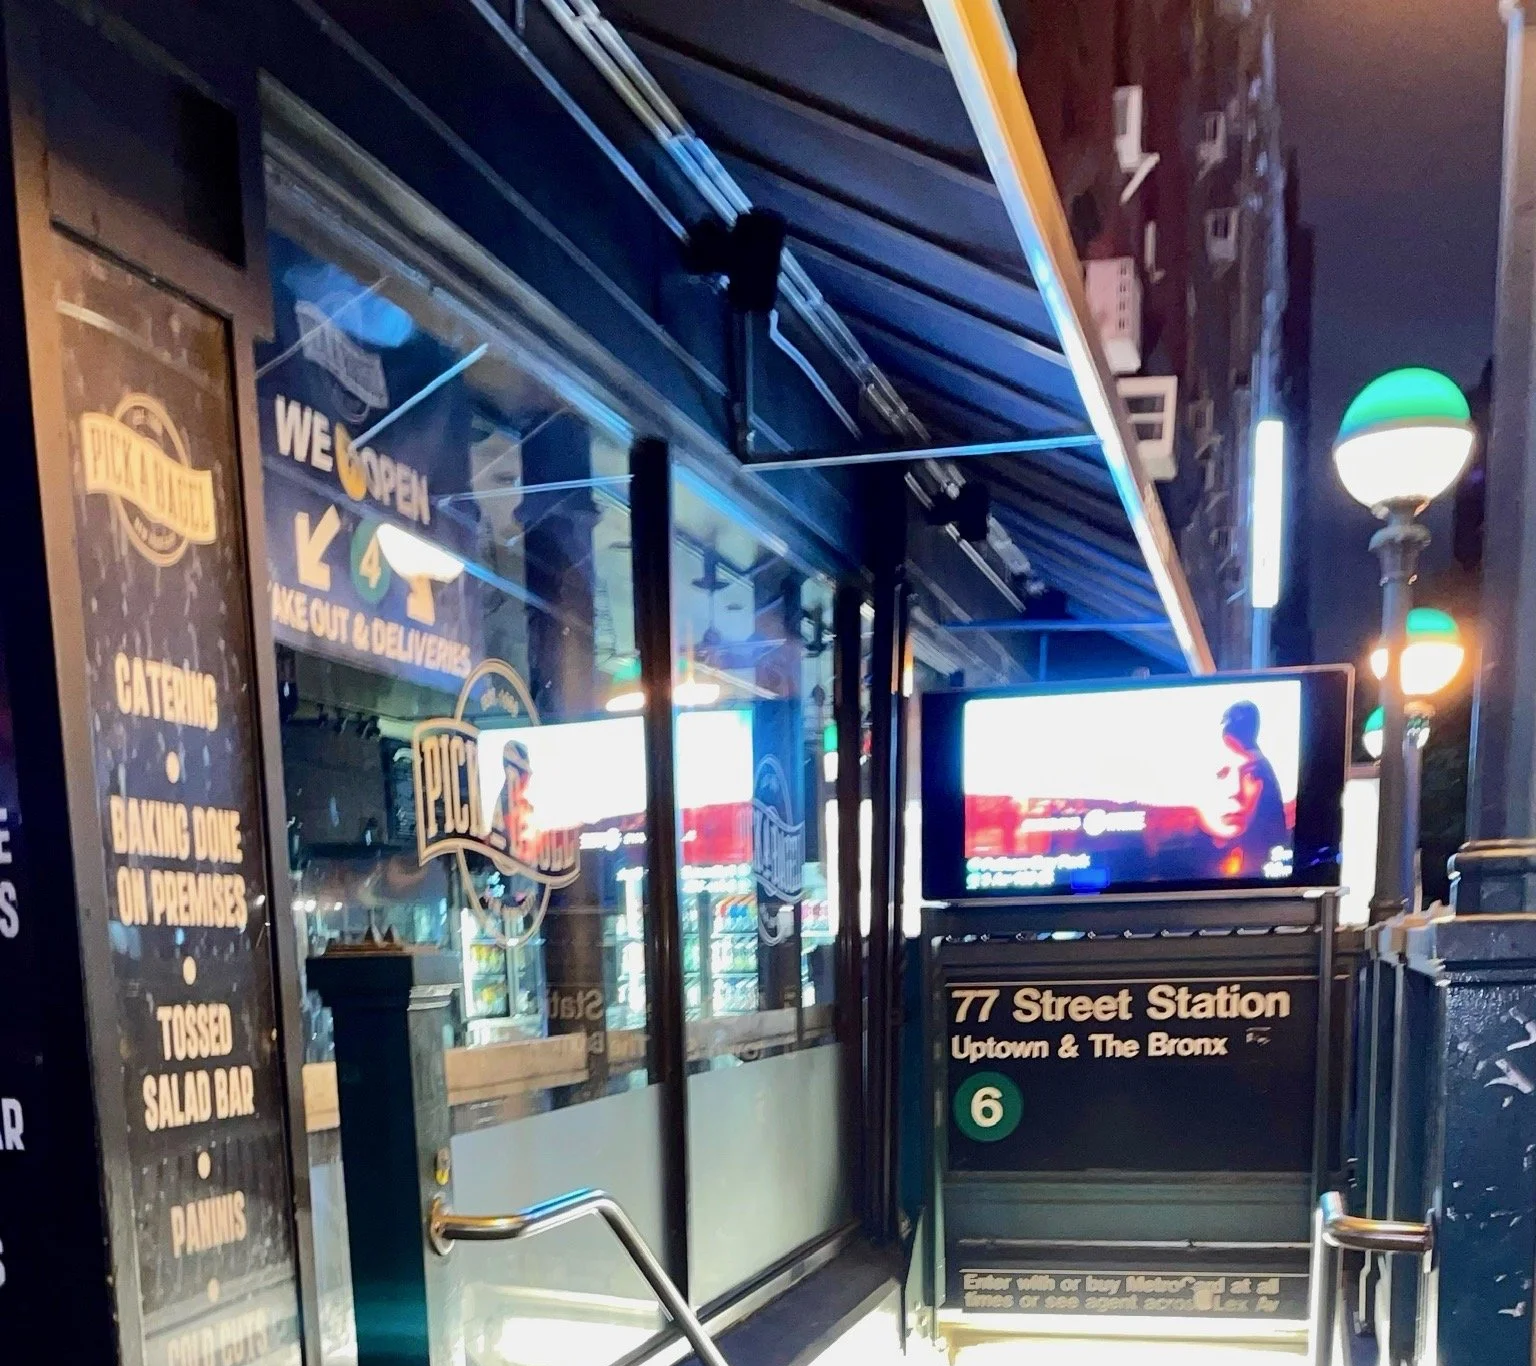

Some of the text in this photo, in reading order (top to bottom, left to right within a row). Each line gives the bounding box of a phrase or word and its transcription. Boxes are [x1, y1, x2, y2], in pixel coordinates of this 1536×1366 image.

[276, 394, 430, 525] WE OPEN
[359, 534, 382, 588] 4
[268, 582, 472, 679] AKE OUT & DELIVERIES
[115, 652, 218, 732] CATERING
[110, 795, 243, 864] BAKING DONE
[117, 866, 248, 928] ON PREMISES
[156, 1003, 233, 1061] TOSSED
[951, 984, 1290, 1023] 77 Street Station
[951, 1032, 1229, 1063] Uptown & The Bronx
[143, 1065, 255, 1132] SALAD BAR
[970, 1086, 1004, 1128] 6
[171, 1190, 247, 1259] PANINIS
[963, 1274, 1012, 1292] Enter
[1016, 1274, 1055, 1292] with
[1060, 1278, 1082, 1292] or
[1085, 1274, 1122, 1294] buy
[1230, 1277, 1251, 1294] at
[1256, 1277, 1280, 1295] all
[1018, 1294, 1041, 1308] or
[1255, 1295, 1280, 1313] Av
[220, 1308, 270, 1366] CUTS
